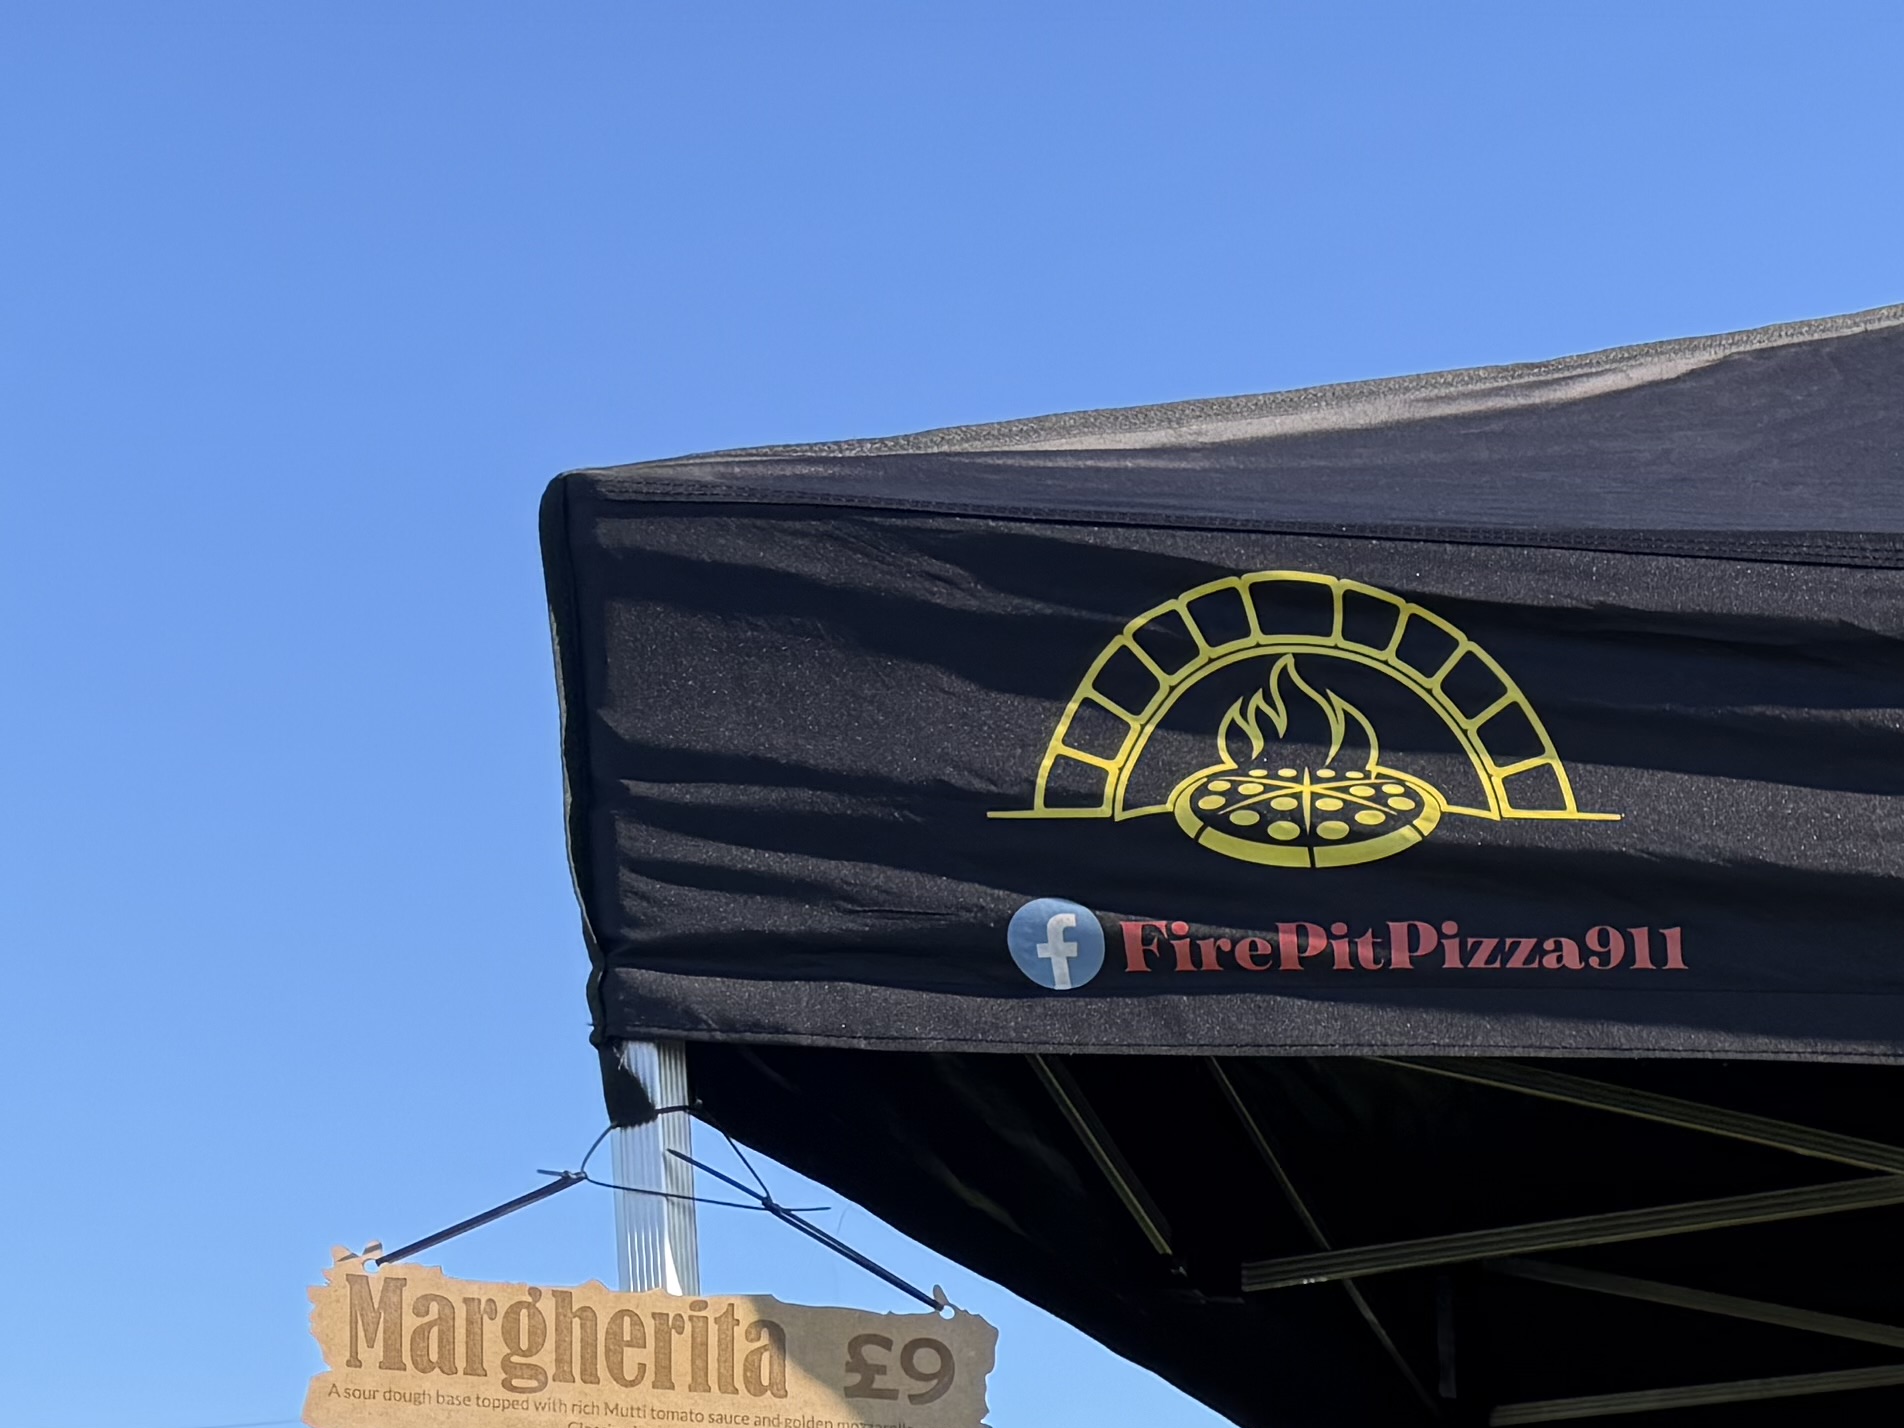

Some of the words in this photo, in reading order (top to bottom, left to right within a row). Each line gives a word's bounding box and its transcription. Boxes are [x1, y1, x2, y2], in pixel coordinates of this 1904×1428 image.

[1118, 920, 1690, 973] FirePitPizza911
[345, 1273, 788, 1398] Margherita
[842, 1333, 955, 1406] £9
[328, 1384, 341, 1398] A
[344, 1387, 379, 1400] sour
[383, 1388, 432, 1406] dough
[436, 1390, 471, 1407] base
[475, 1393, 529, 1412] topped
[534, 1398, 567, 1414] with
[571, 1401, 599, 1416] rich
[604, 1402, 646, 1419] Mutti
[651, 1409, 704, 1424] tomato
[708, 1413, 749, 1426] sauce
[754, 1414, 780, 1428] and
